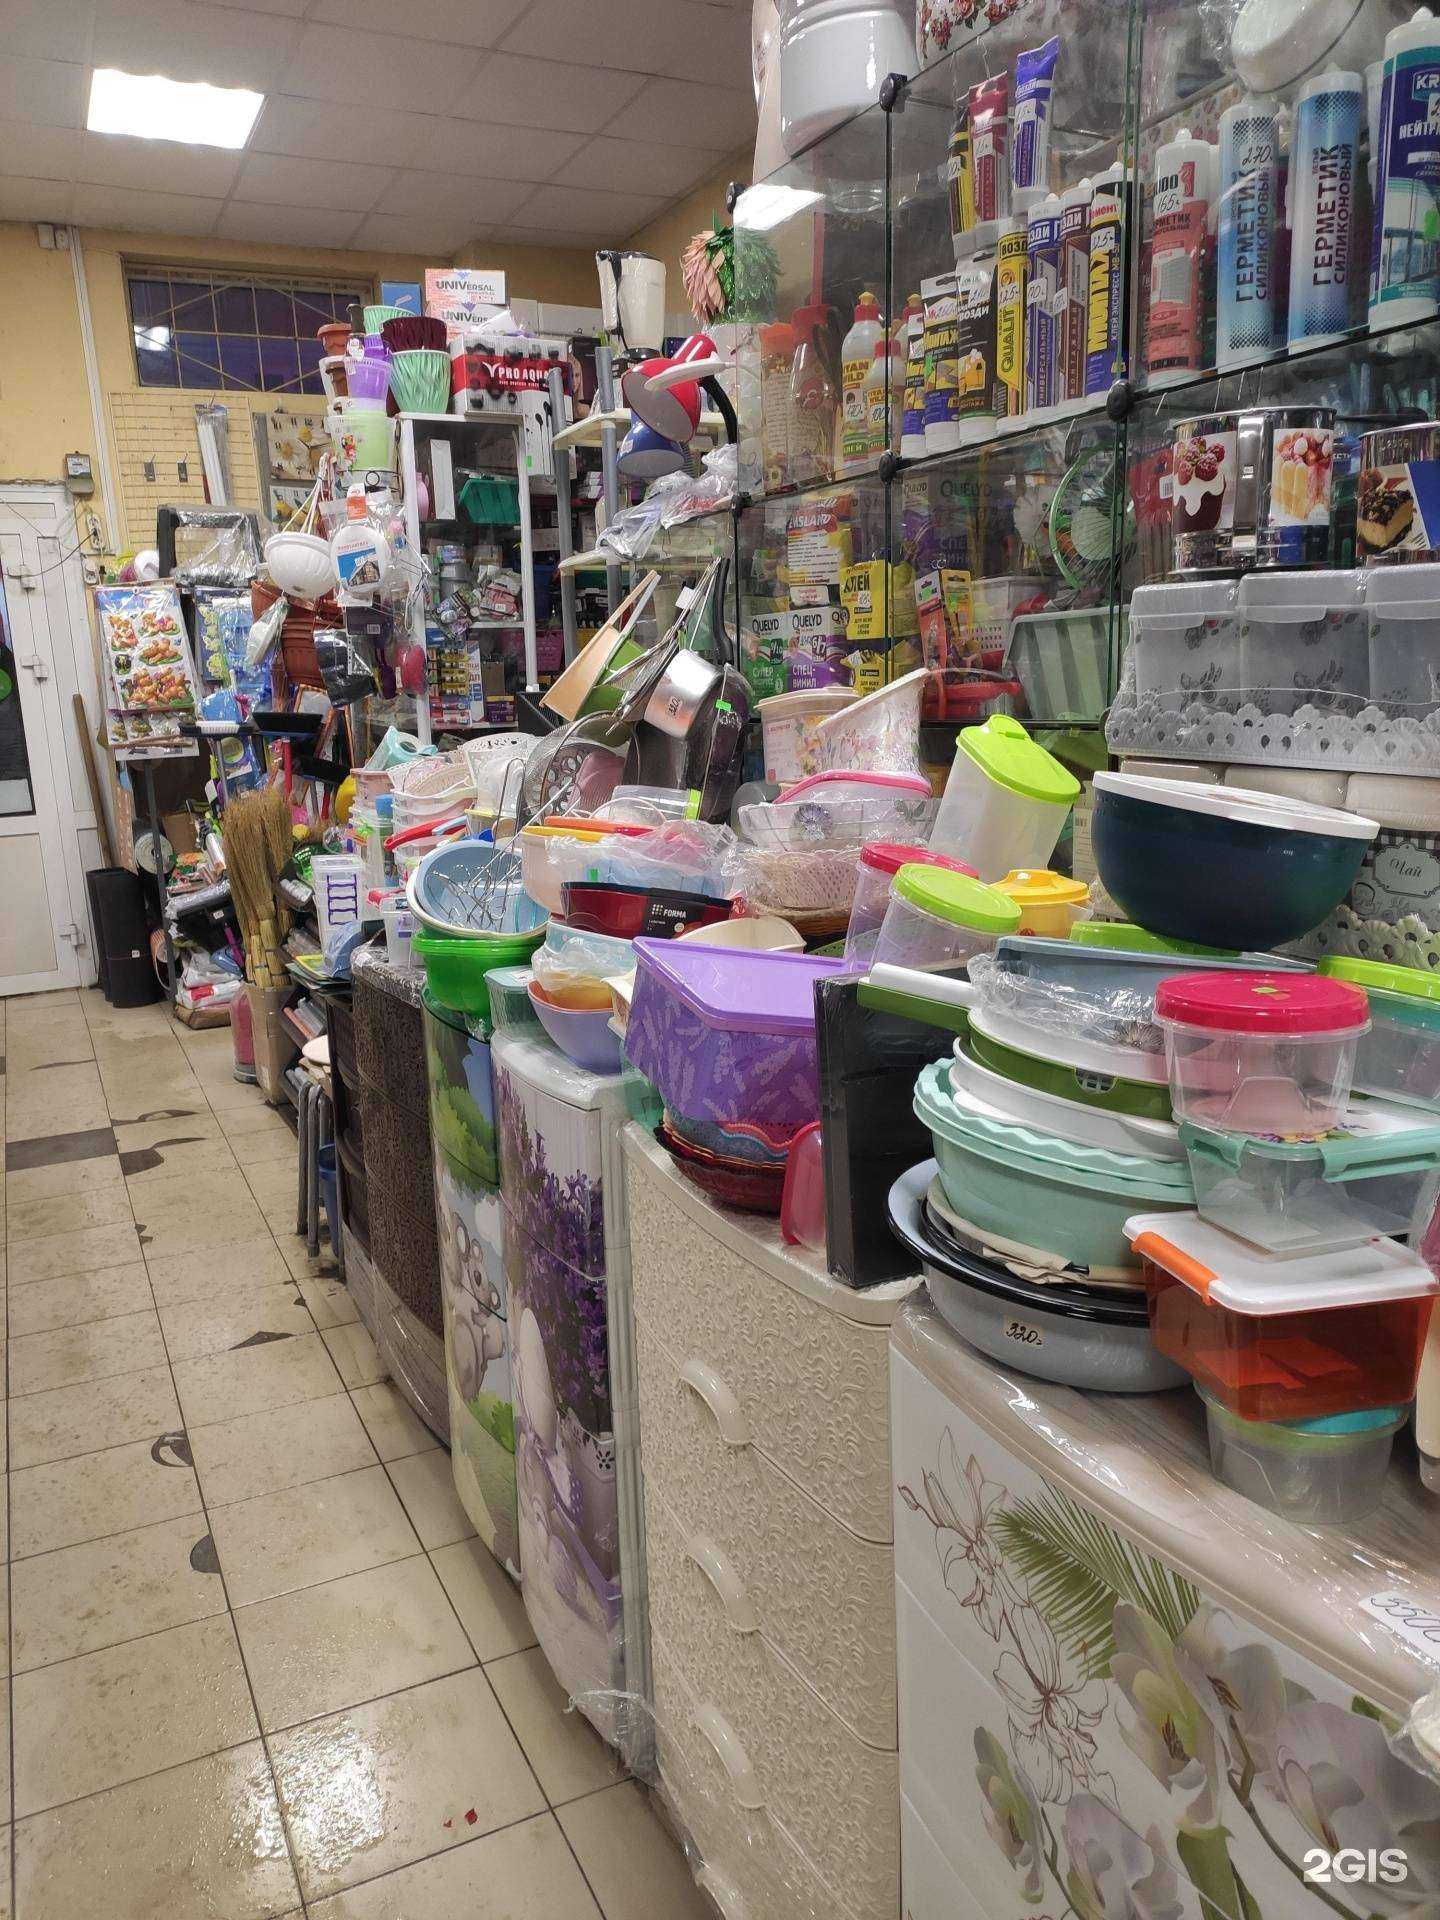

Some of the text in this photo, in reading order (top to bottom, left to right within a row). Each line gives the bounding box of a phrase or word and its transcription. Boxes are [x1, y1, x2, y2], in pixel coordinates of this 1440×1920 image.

[1313, 144, 1339, 286] ГЕРМЕТИК
[1334, 143, 1353, 285] СИЛИКОНОВЫЙ
[1235, 167, 1257, 302] ГЕРМЕТИК
[436, 280, 495, 293] UNIVERSAL
[498, 366, 520, 380] PRO
[752, 618, 780, 635] QUELYD
[792, 613, 822, 632] QUELYD
[792, 664, 816, 677] СПЕЦ-
[792, 678, 817, 688] ВИНИЛ
[1390, 858, 1422, 878] Чай
[663, 908, 687, 918] FORMA
